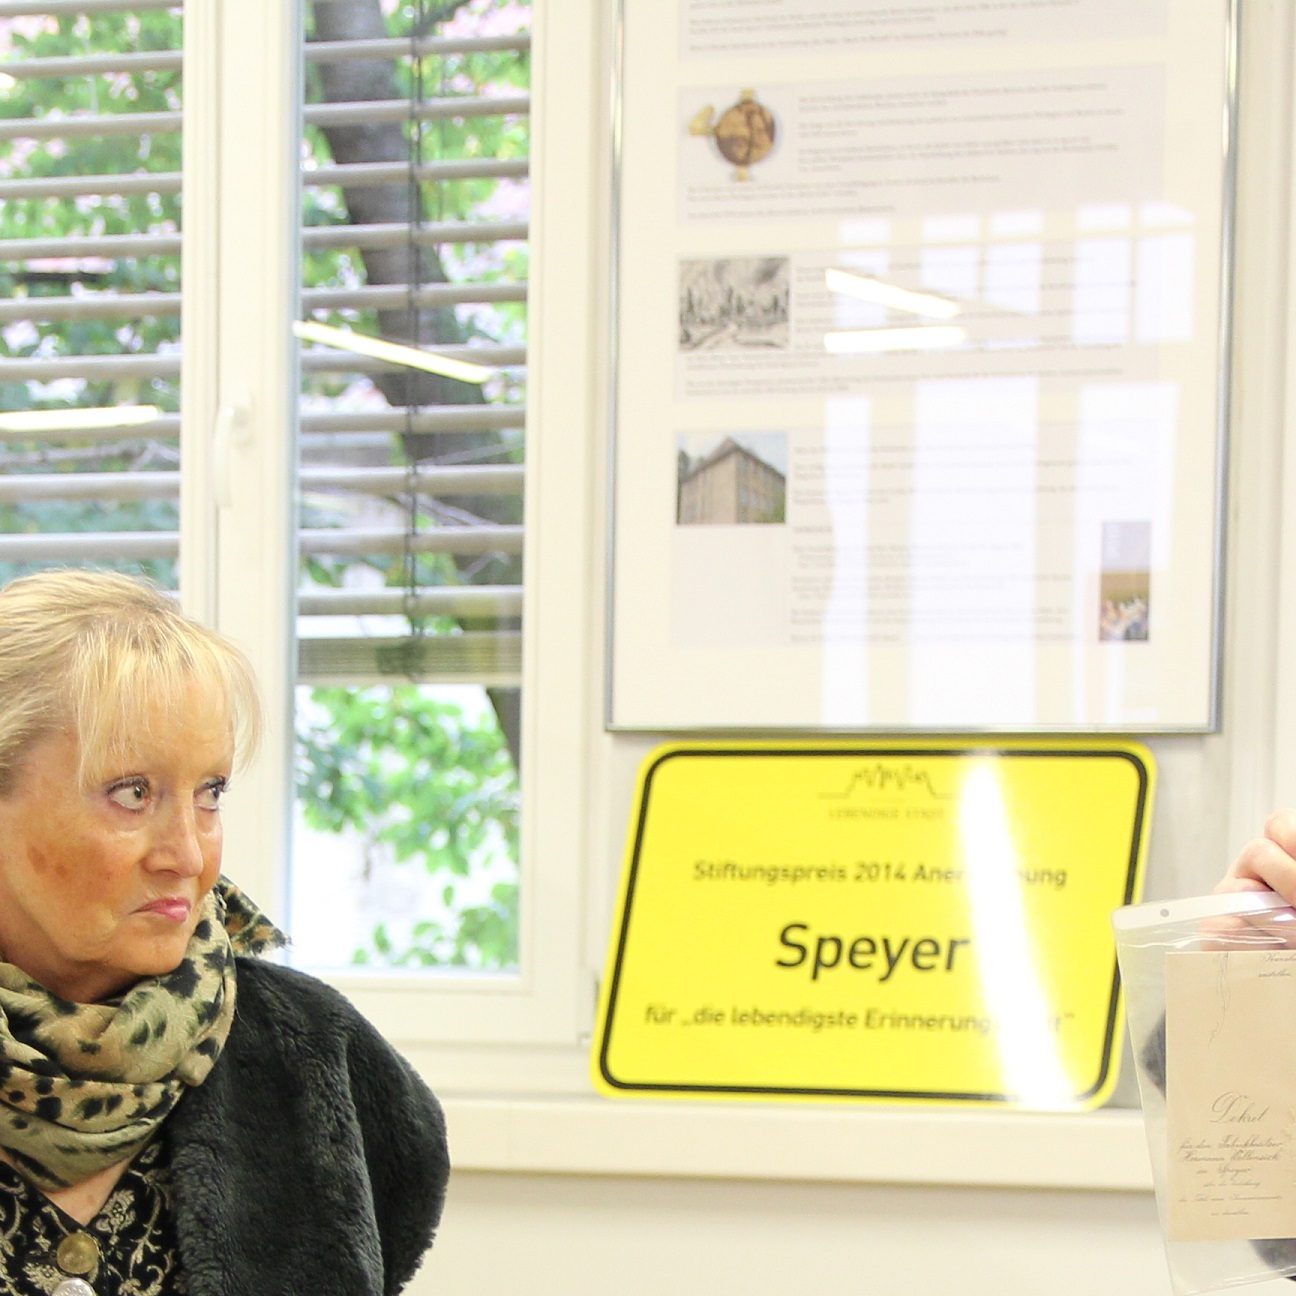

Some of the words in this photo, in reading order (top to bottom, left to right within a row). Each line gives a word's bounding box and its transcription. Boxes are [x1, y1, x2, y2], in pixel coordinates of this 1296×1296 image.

[692, 859, 848, 886] Stiftungspreis
[854, 864, 908, 882] 2014
[775, 922, 970, 982] Speyer
[645, 1005, 675, 1025] für
[731, 1007, 858, 1032] lebendigste
